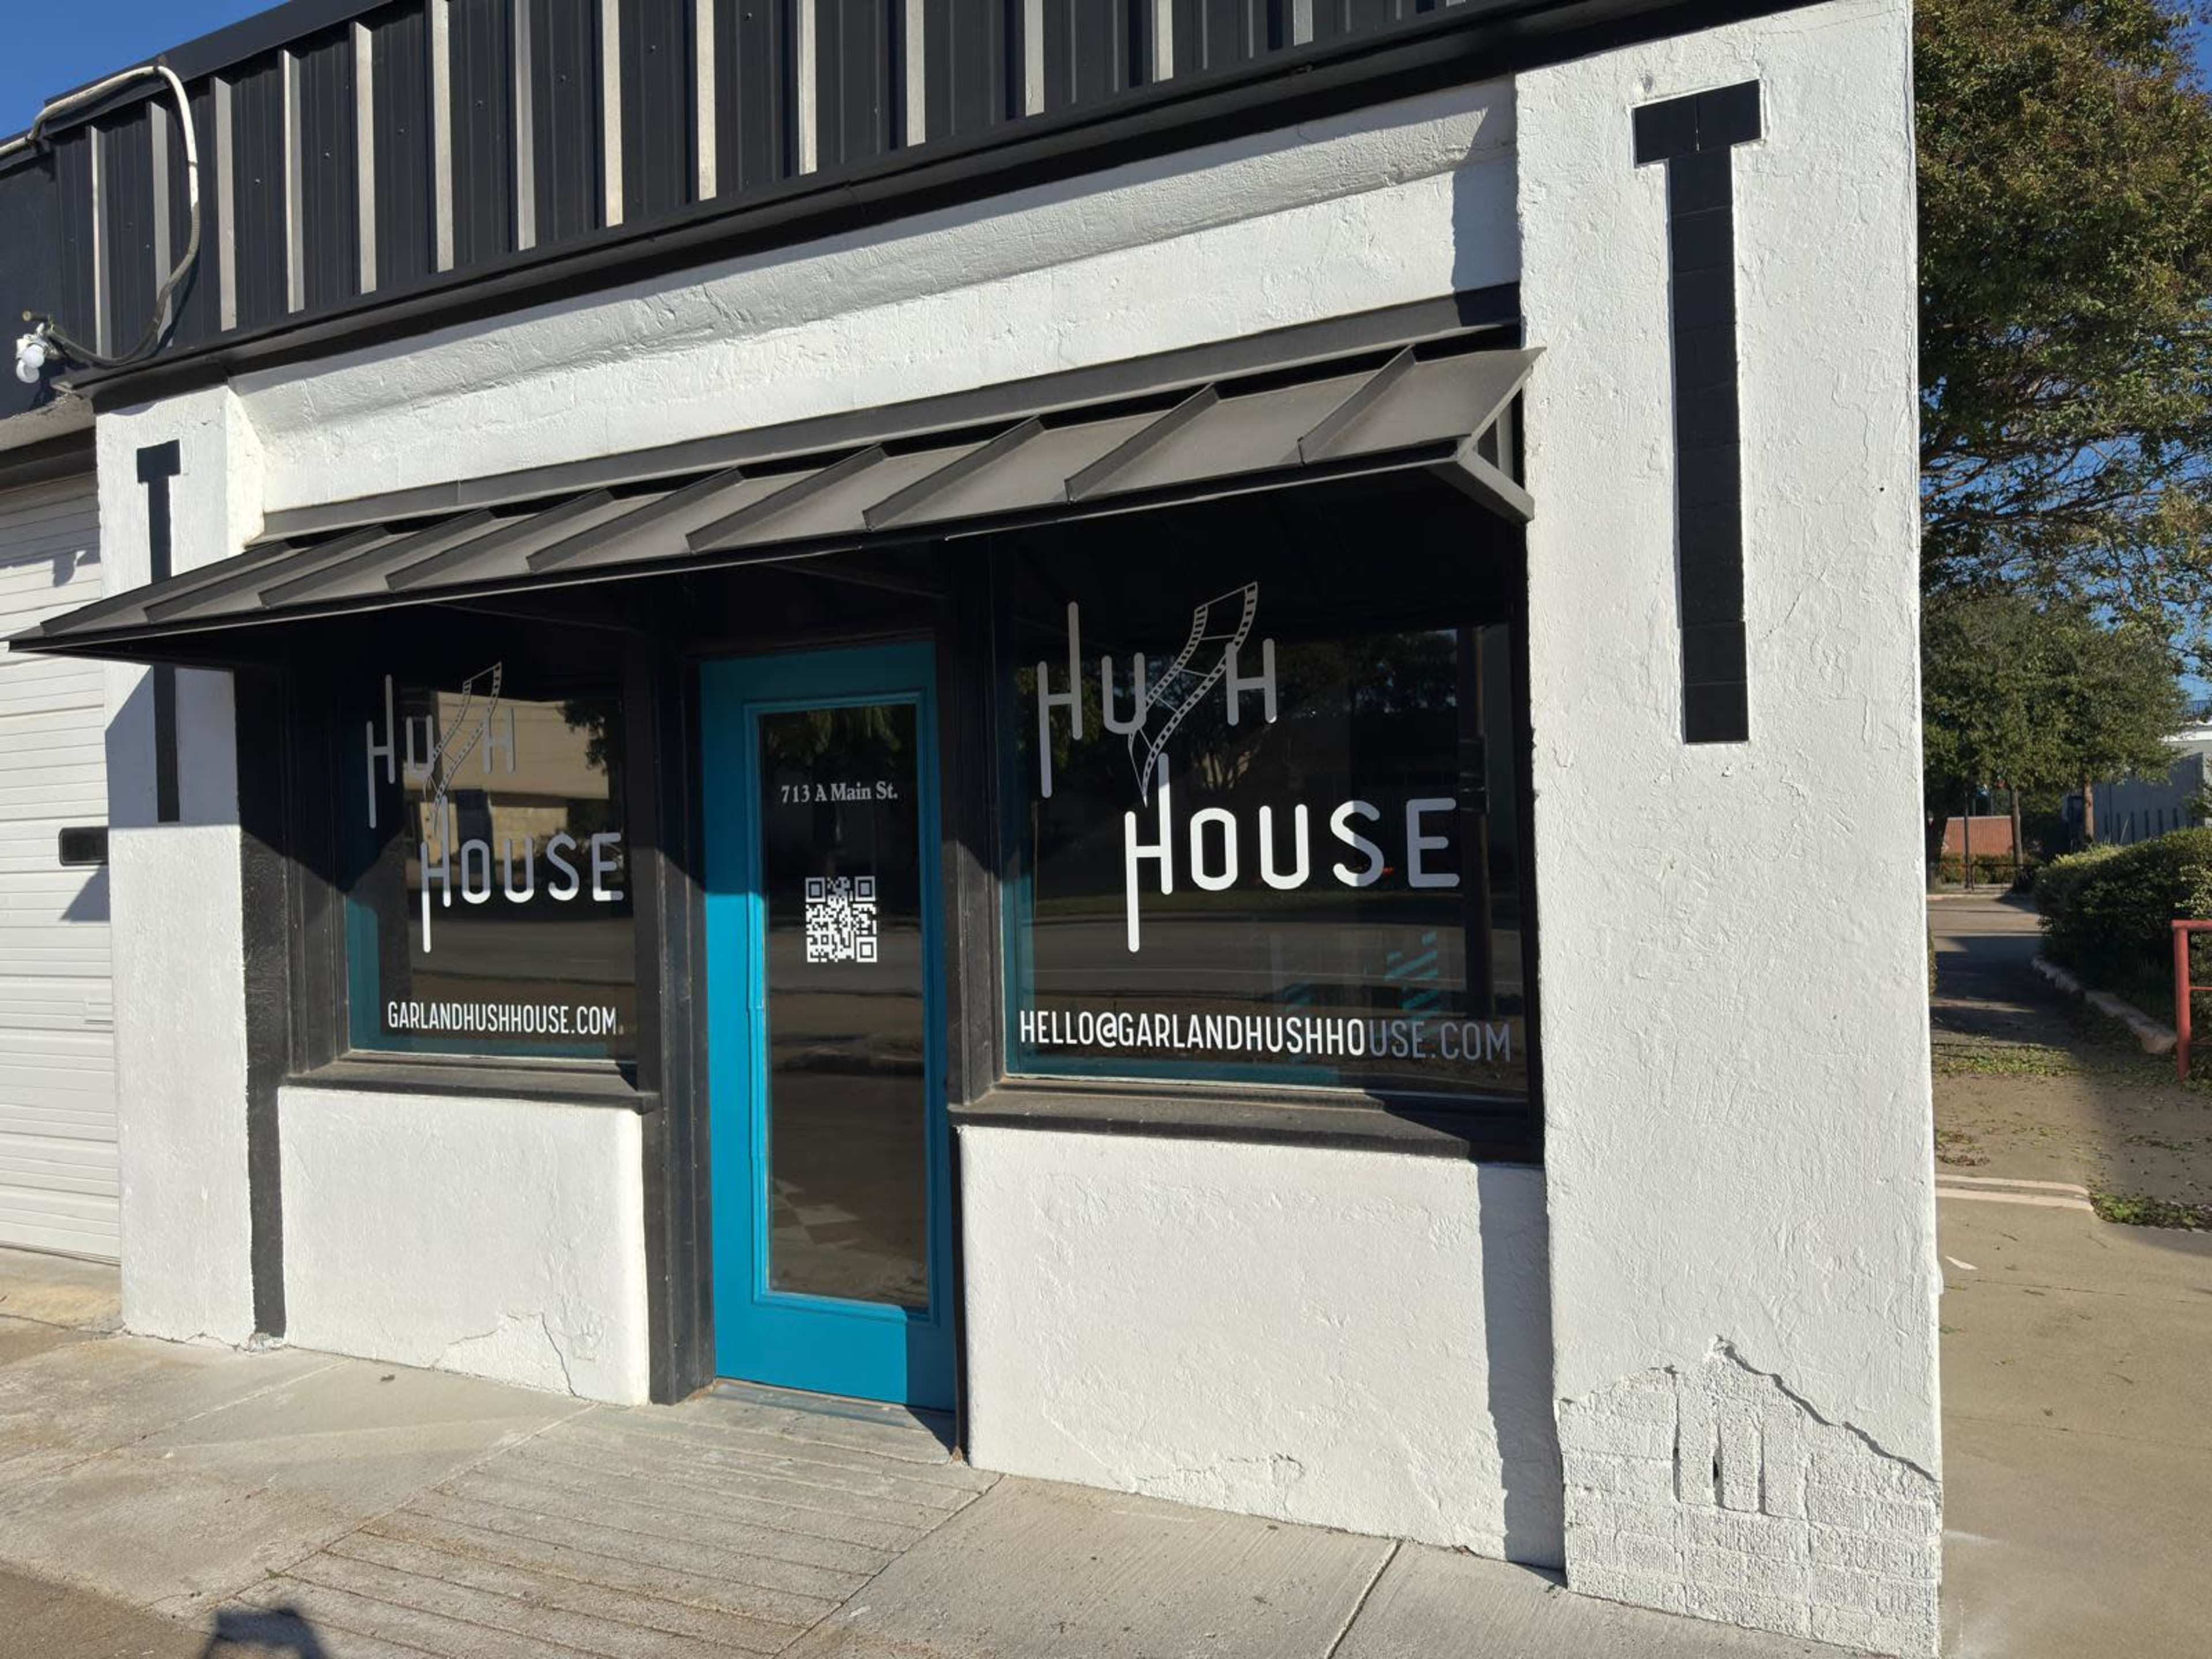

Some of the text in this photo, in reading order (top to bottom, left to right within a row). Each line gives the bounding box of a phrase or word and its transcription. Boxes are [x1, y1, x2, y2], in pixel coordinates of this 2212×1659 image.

[781, 781, 899, 804] 713 A Main St.
[421, 794, 624, 953] HOUSE
[1124, 752, 1460, 953] HOUSE
[388, 1001, 616, 1035] GARLANDHUSHHOUSE.COM
[1020, 1009, 1511, 1062] HELLO@GARLANDHUSHHOUSE.COM
